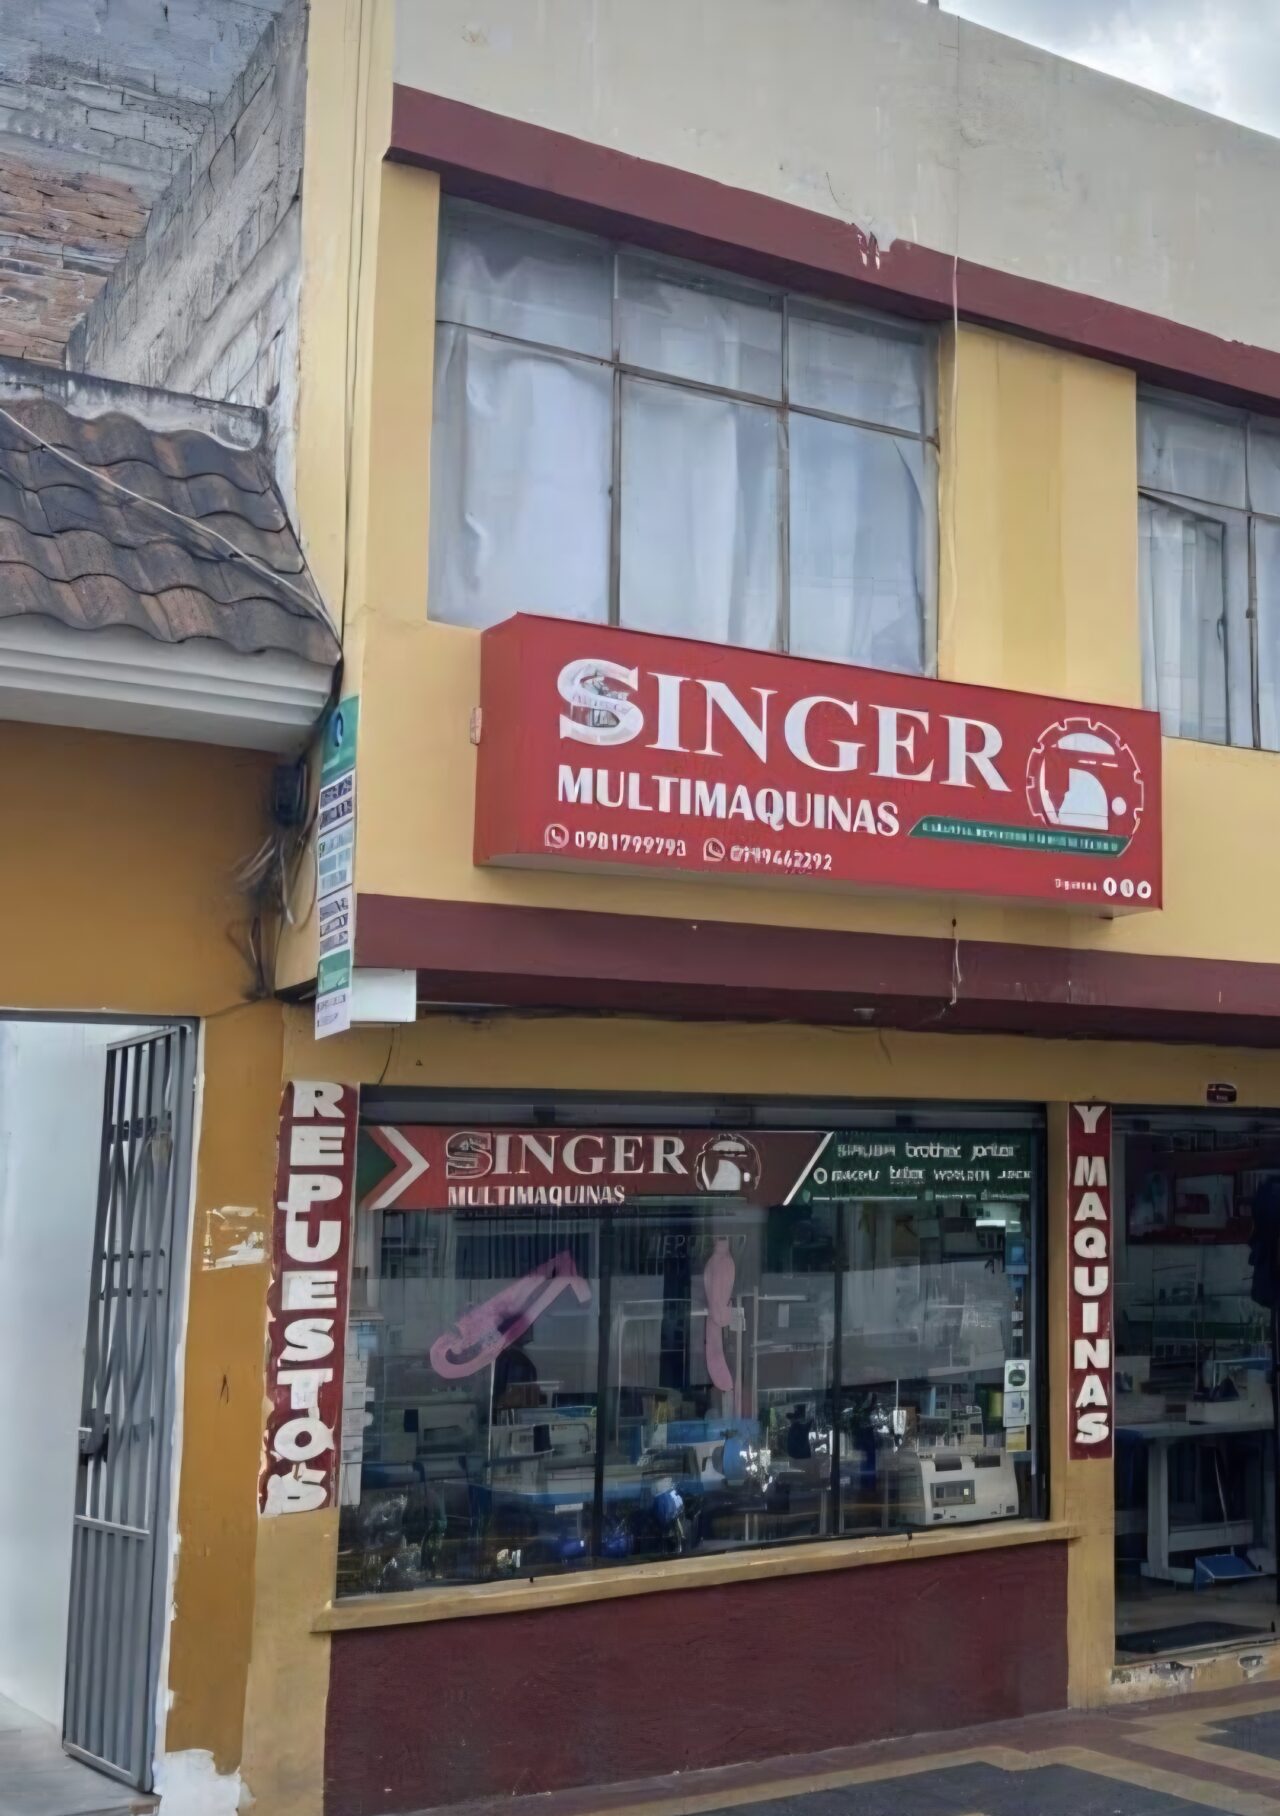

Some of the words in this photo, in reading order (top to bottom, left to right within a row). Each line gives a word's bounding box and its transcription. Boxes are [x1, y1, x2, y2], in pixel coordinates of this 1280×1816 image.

[557, 658, 1012, 793] SINGER
[557, 764, 900, 837] MULTIMAQUINAS
[446, 1131, 688, 1180] SINGER
[1073, 1105, 1107, 1134] Y
[448, 1184, 625, 1207] MULTIMAQUINAS
[263, 1080, 346, 1515] REPUESTOS
[1073, 1156, 1110, 1444] MAQUINAS
